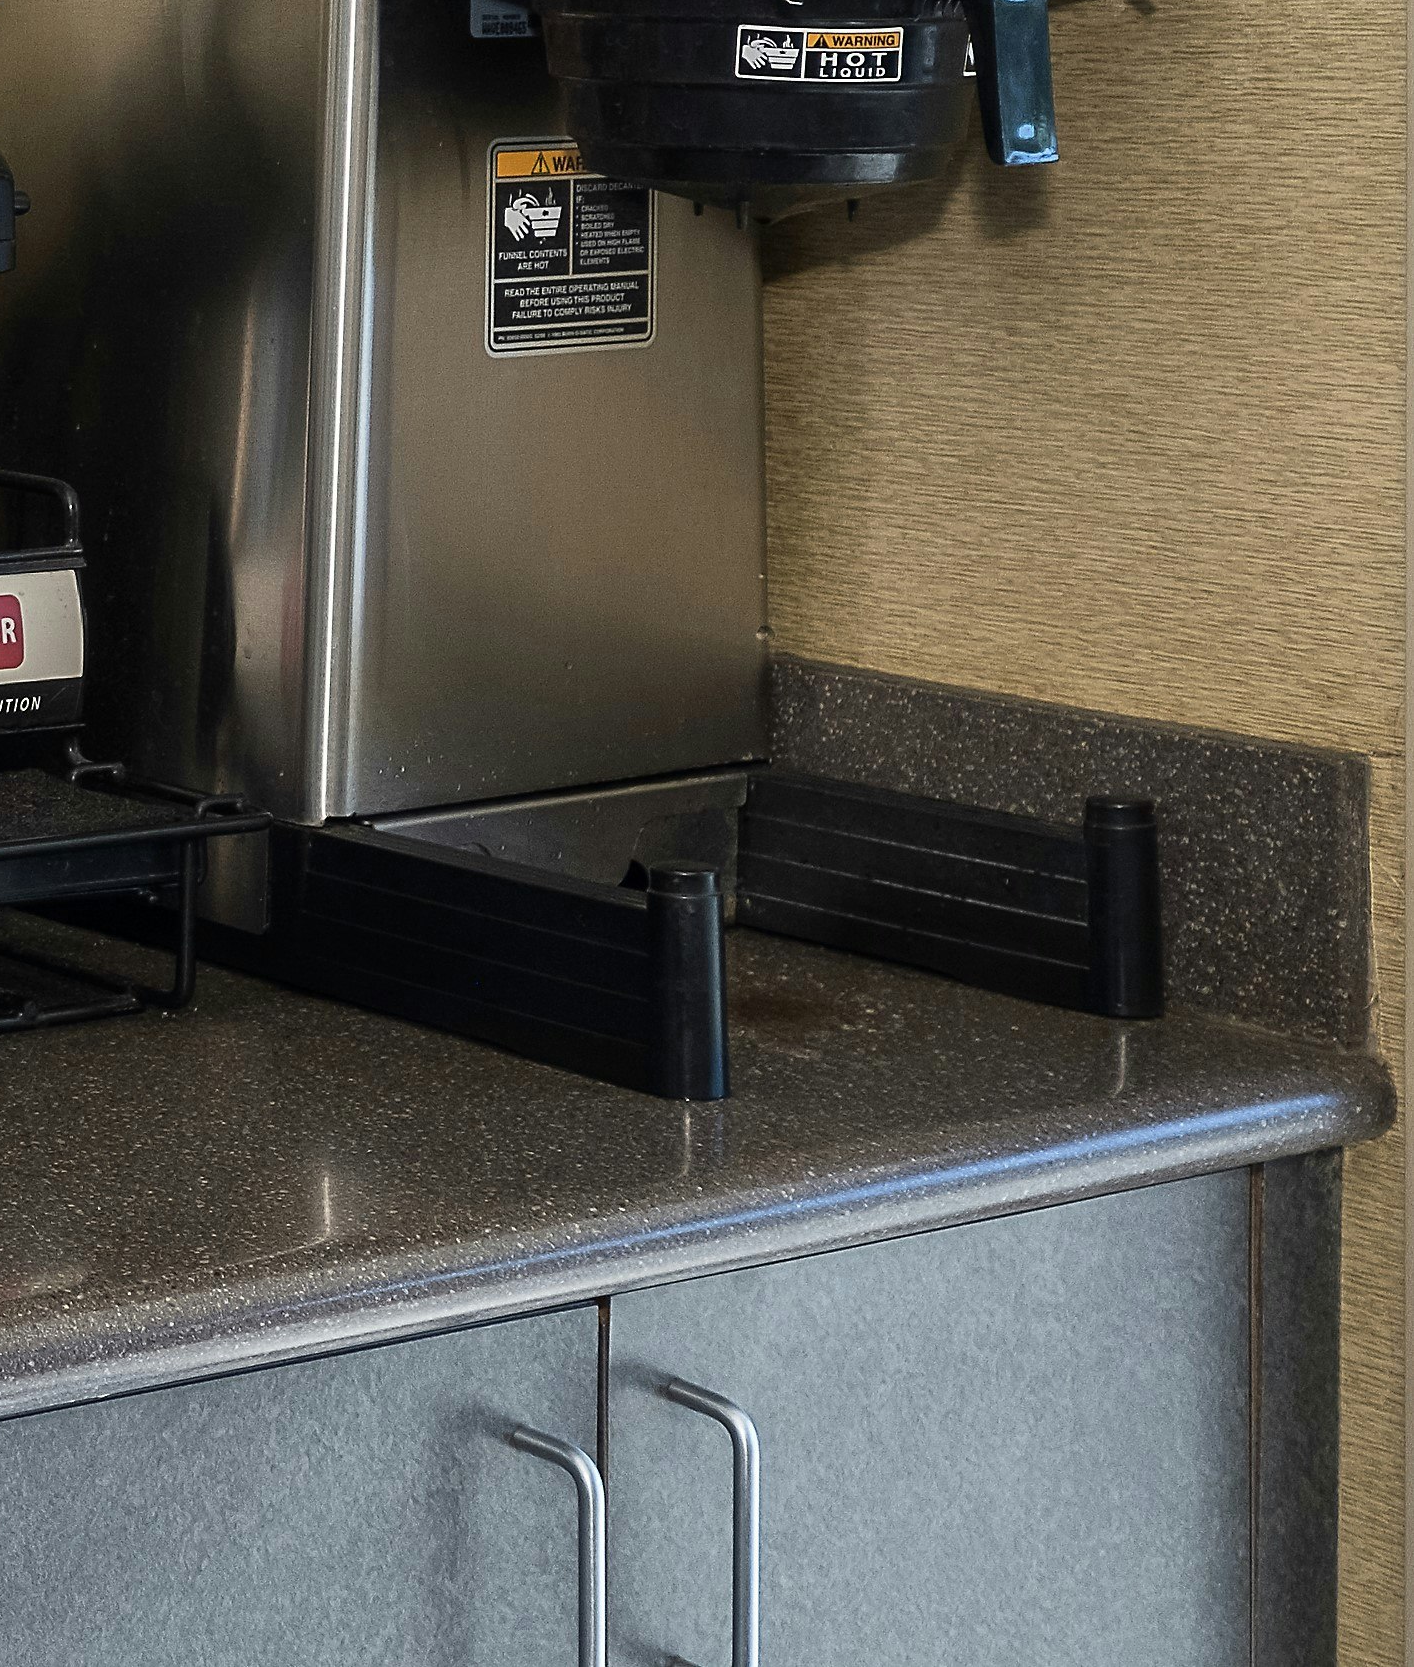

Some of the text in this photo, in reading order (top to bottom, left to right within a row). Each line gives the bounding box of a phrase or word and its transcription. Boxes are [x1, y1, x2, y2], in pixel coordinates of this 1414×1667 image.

[832, 35, 895, 47] WARNING
[821, 52, 887, 67] HOT
[820, 67, 886, 78] LIQUID
[608, 182, 644, 191] DECAN
[498, 248, 568, 261] FUNNEL CONTENTS
[517, 260, 549, 271] ARE HOT
[504, 281, 639, 298] READ THE ENTIRE OPERATING MANUAL
[519, 293, 625, 308] BEFORE USING THIS PRODUCT
[511, 303, 632, 319] FAILURE TO COMPLY RISKS INJURY
